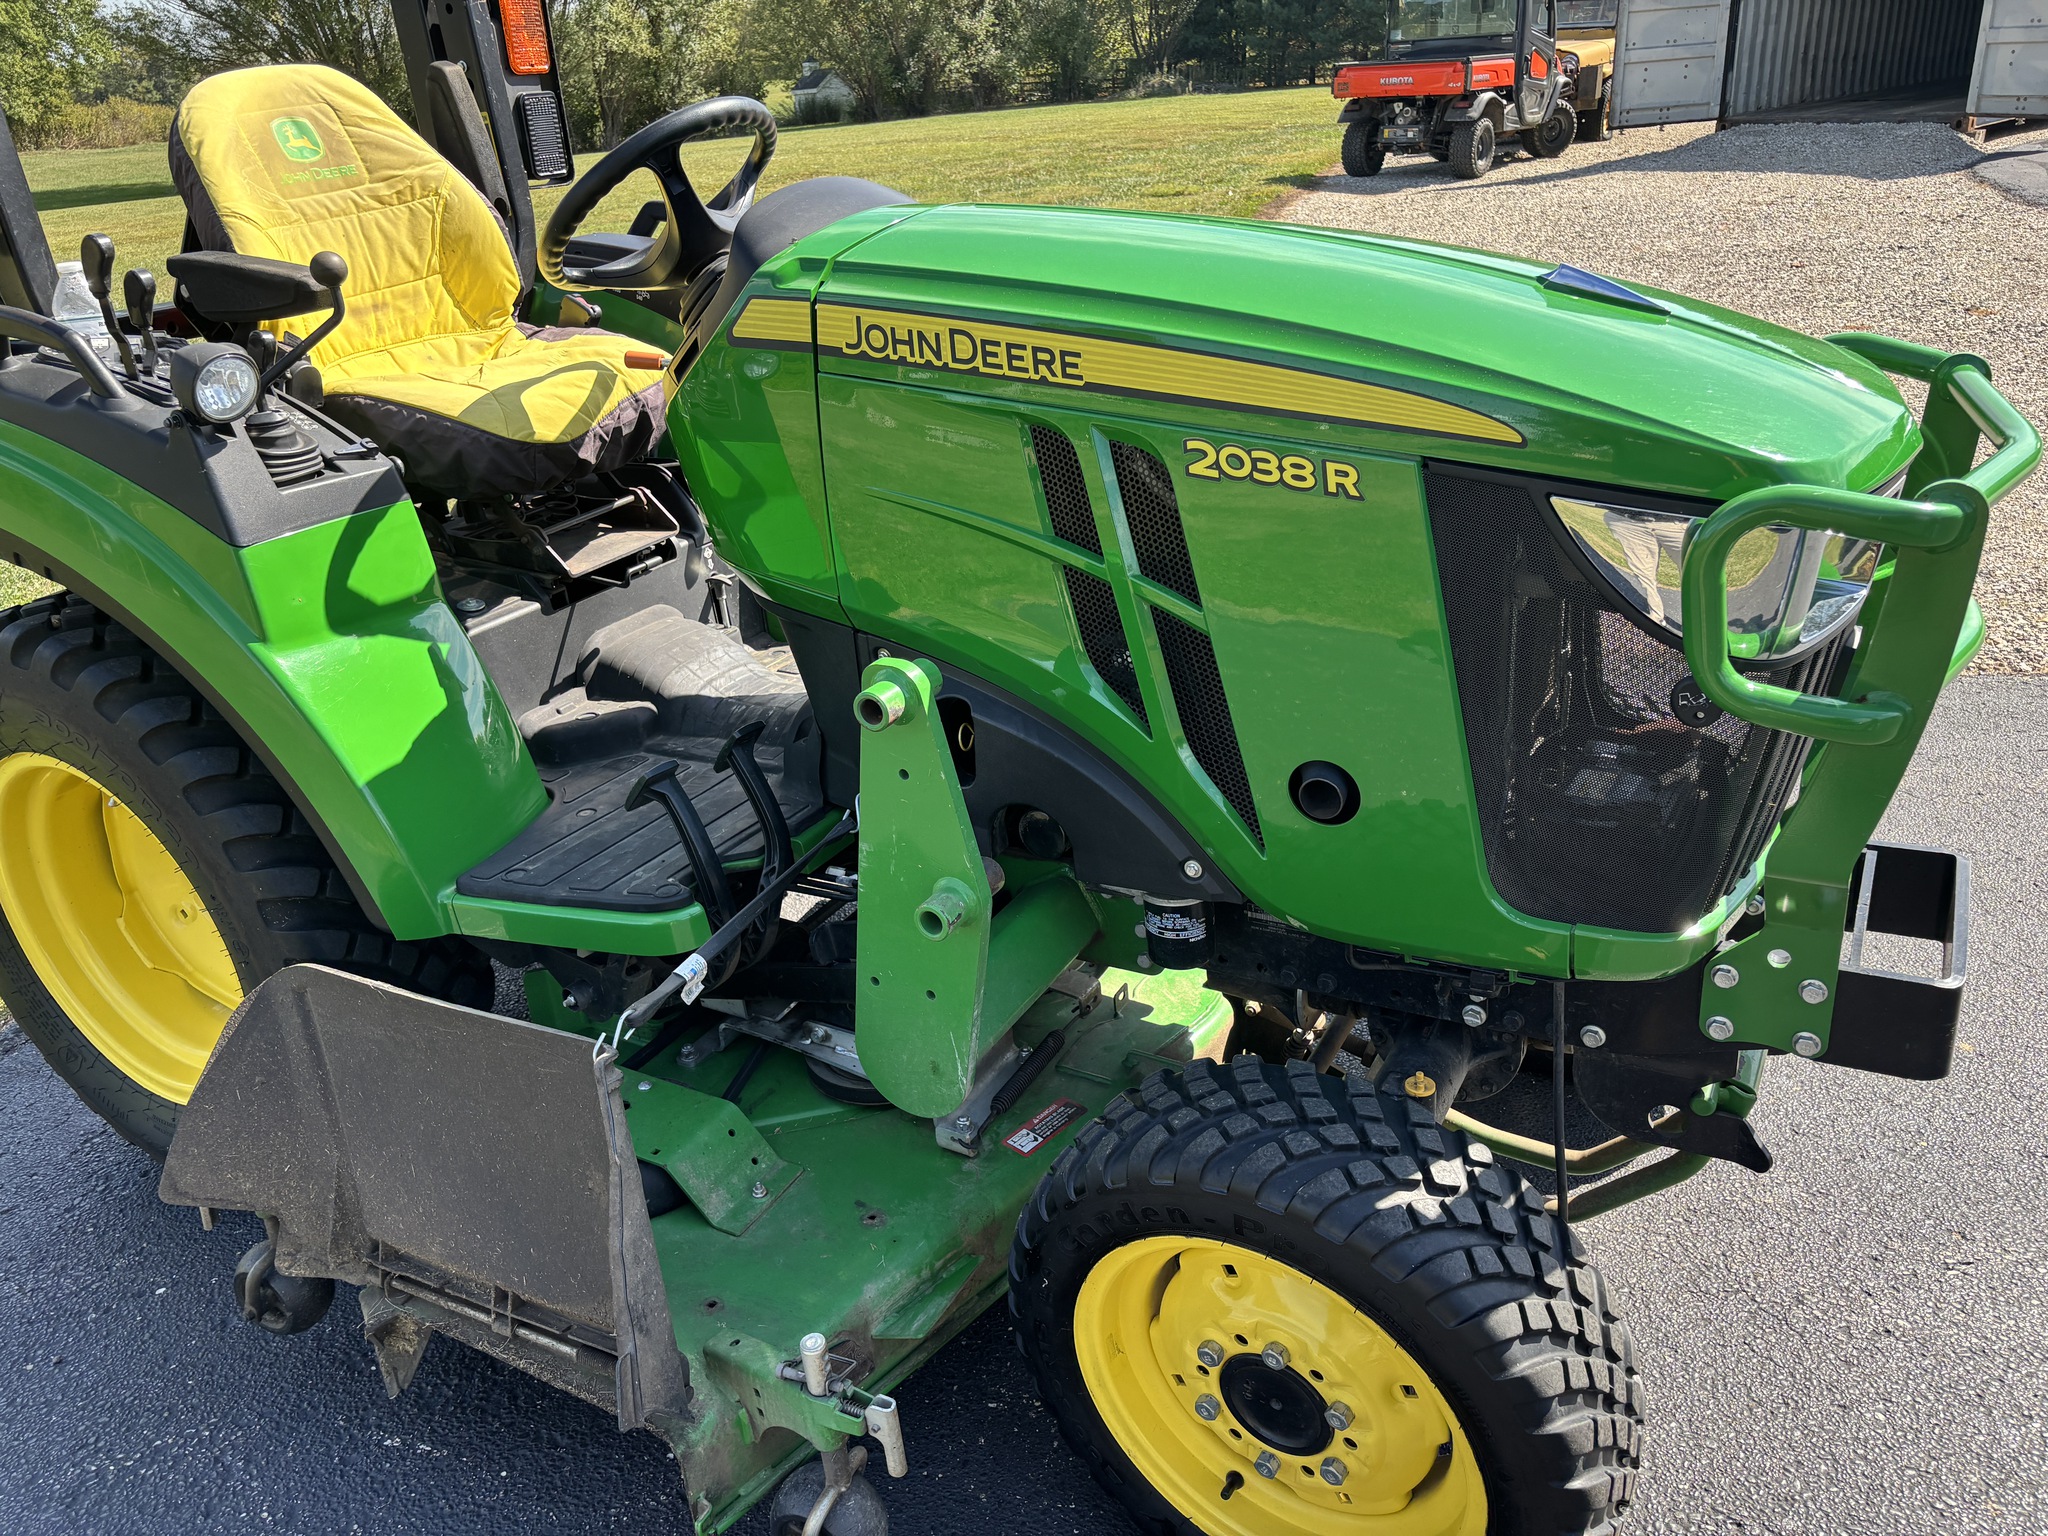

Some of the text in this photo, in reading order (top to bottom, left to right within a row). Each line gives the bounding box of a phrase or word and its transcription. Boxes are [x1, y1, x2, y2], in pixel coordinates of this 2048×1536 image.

[1379, 76, 1414, 84] KUBOTA
[281, 165, 358, 184] JOHN DEERE
[843, 315, 1085, 385] JOHN DEERE
[1183, 438, 1364, 500] 2038 R
[1055, 1201, 1191, 1250] Garden
